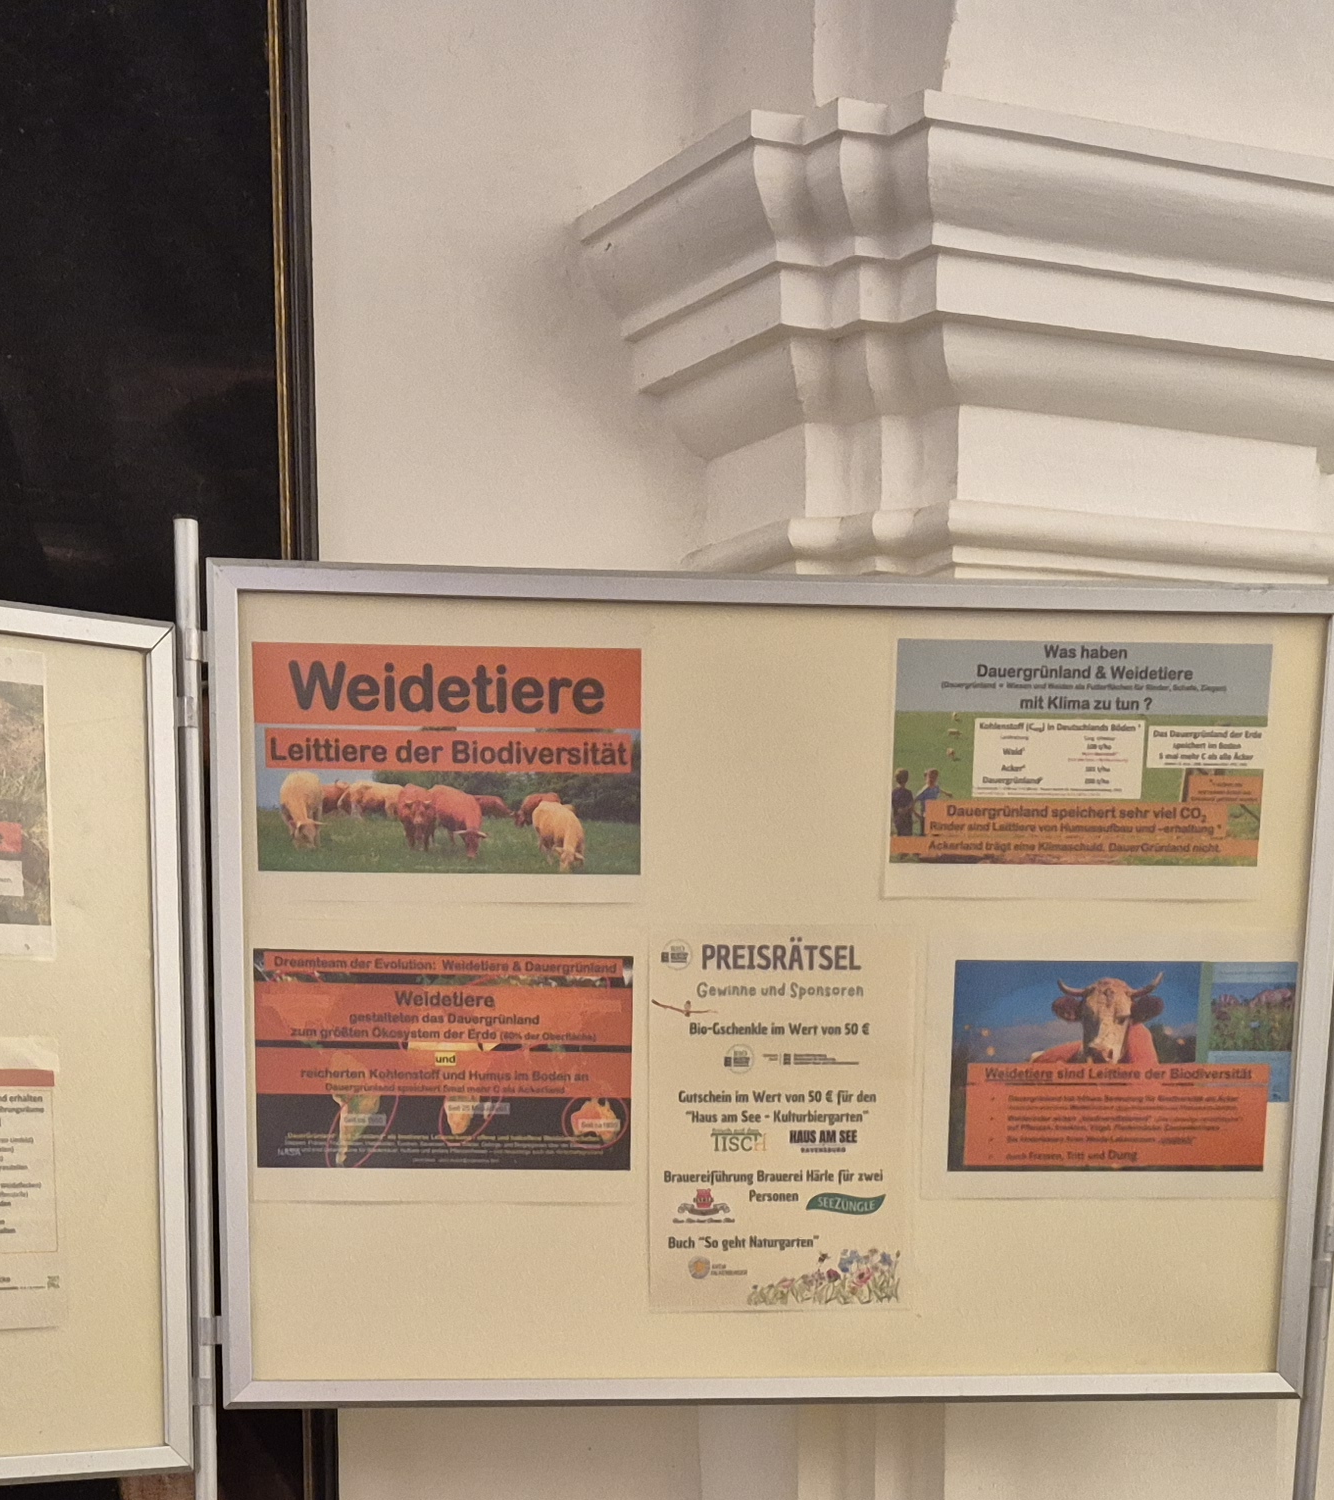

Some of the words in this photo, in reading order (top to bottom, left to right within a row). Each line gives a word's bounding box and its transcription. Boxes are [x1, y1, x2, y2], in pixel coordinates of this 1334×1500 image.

[1043, 643, 1077, 661] Was
[1080, 644, 1128, 661] haben
[976, 664, 1092, 683] Dauergrünland
[1094, 665, 1107, 681] &
[1109, 664, 1194, 682] Weidetiere
[288, 659, 606, 715] Weidetiere
[1019, 695, 1045, 711] mit
[1046, 695, 1092, 712] Klima
[1094, 698, 1113, 712] zu
[1115, 697, 1141, 712] tun
[1143, 696, 1154, 712] ?
[270, 737, 388, 764] Leittiere
[395, 739, 443, 764] der
[451, 739, 628, 767] Biodiversität
[700, 936, 862, 971] PREISRÄTSEL
[273, 956, 348, 969] Dreamteam
[350, 957, 371, 970] der
[374, 958, 437, 972] Evolution:
[394, 990, 496, 1008] Weidetiere
[696, 981, 757, 999] Gewinne
[761, 982, 786, 998] und
[790, 981, 864, 1001] Sponsoren
[689, 1021, 768, 1036] Bio-Gschenkle
[770, 1022, 785, 1036] im
[788, 1022, 819, 1036] Wert
[821, 1025, 842, 1036] von
[844, 1022, 859, 1036] 50
[861, 1022, 870, 1036] €
[434, 1053, 456, 1065] und
[678, 1089, 732, 1104] Gutschein
[734, 1090, 749, 1104] im
[751, 1090, 781, 1104] Wert
[784, 1093, 806, 1104] von
[808, 1090, 823, 1104] 50
[825, 1090, 834, 1104] €
[836, 1090, 854, 1106] für
[856, 1090, 877, 1104] den
[721, 1113, 738, 1124] am
[740, 1110, 762, 1124] See
[789, 1129, 817, 1144] HAUS
[819, 1129, 837, 1144] AM
[839, 1129, 858, 1144] SEE
[663, 1170, 754, 1186] Brauereiführung
[756, 1170, 804, 1184] Brauerei
[806, 1169, 835, 1183] Härle
[837, 1169, 855, 1186] für
[857, 1169, 884, 1183] zwei
[748, 1189, 799, 1203] Personen
[667, 1236, 696, 1250] Buch
[722, 1236, 746, 1251] geht
